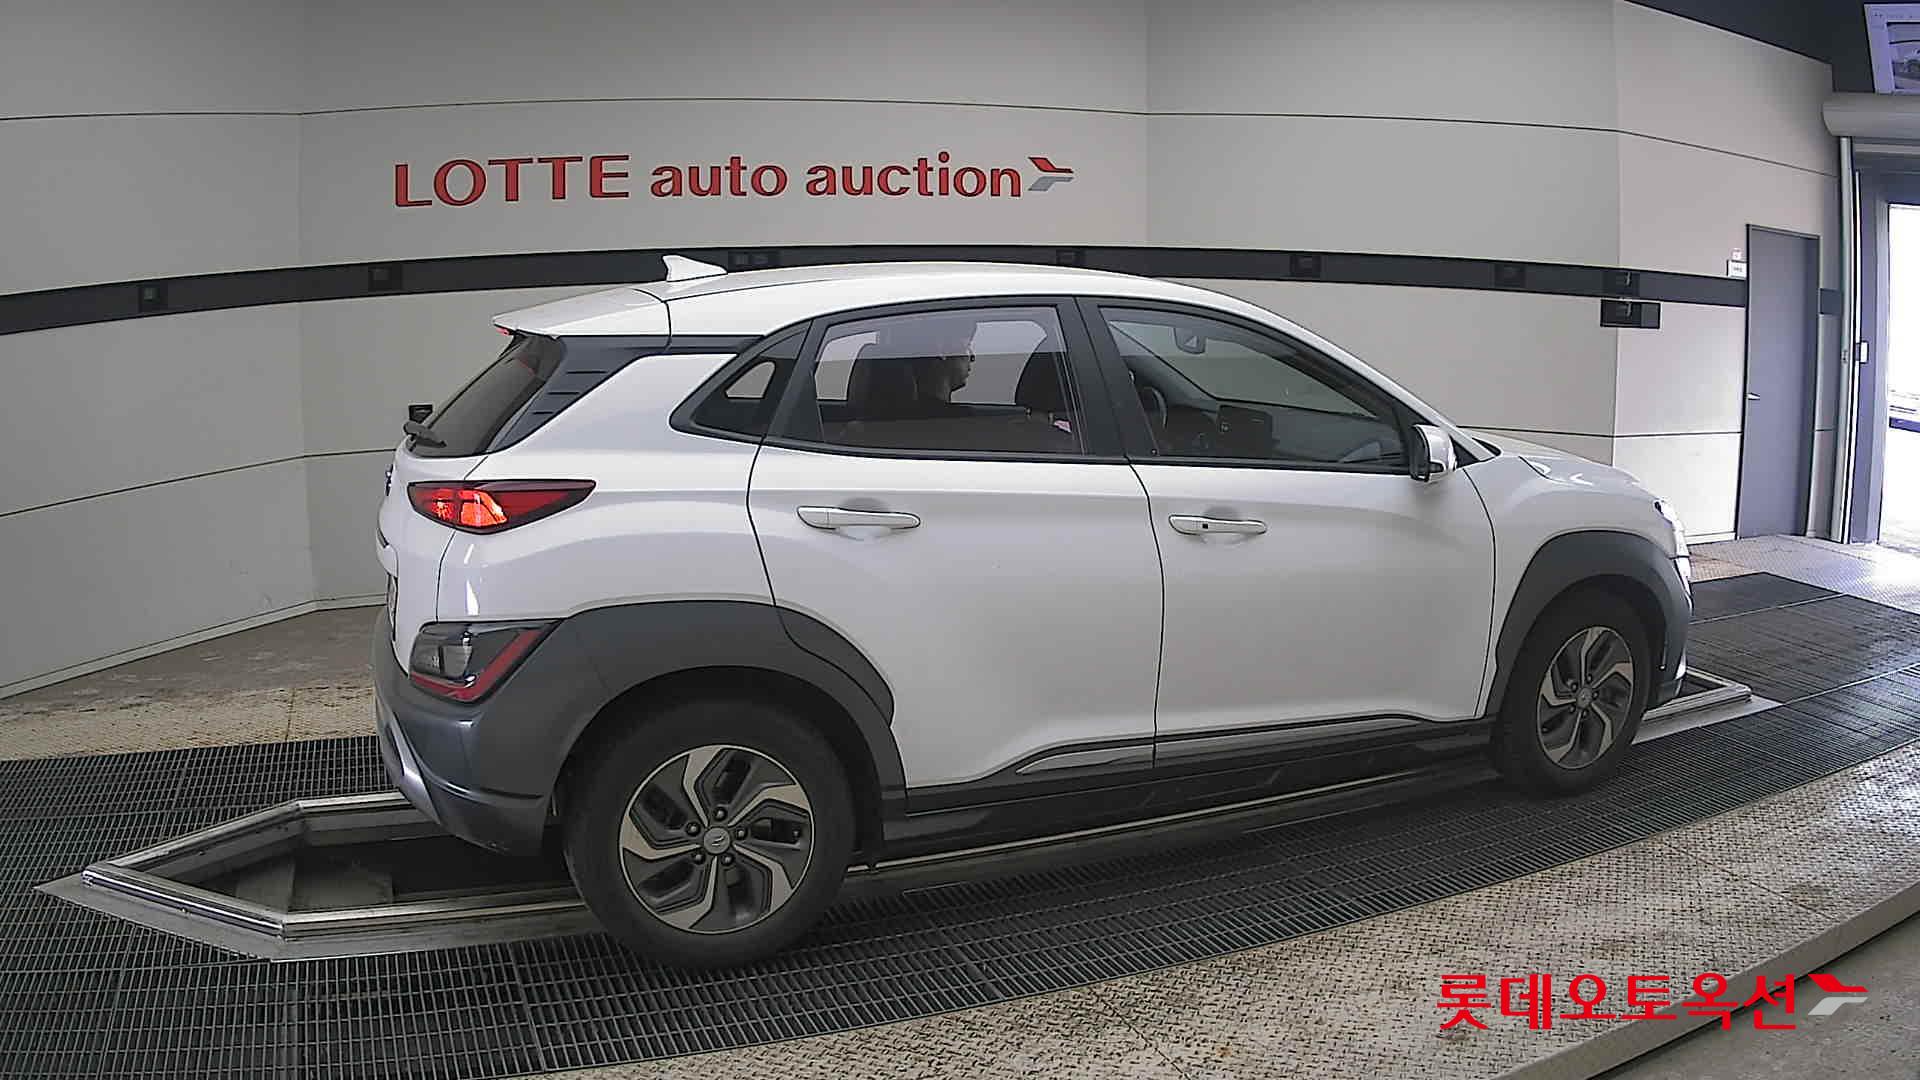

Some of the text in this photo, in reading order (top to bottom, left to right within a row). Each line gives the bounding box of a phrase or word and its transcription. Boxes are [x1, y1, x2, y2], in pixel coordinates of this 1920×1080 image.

[394, 151, 1022, 208] LOTTE auto auction
